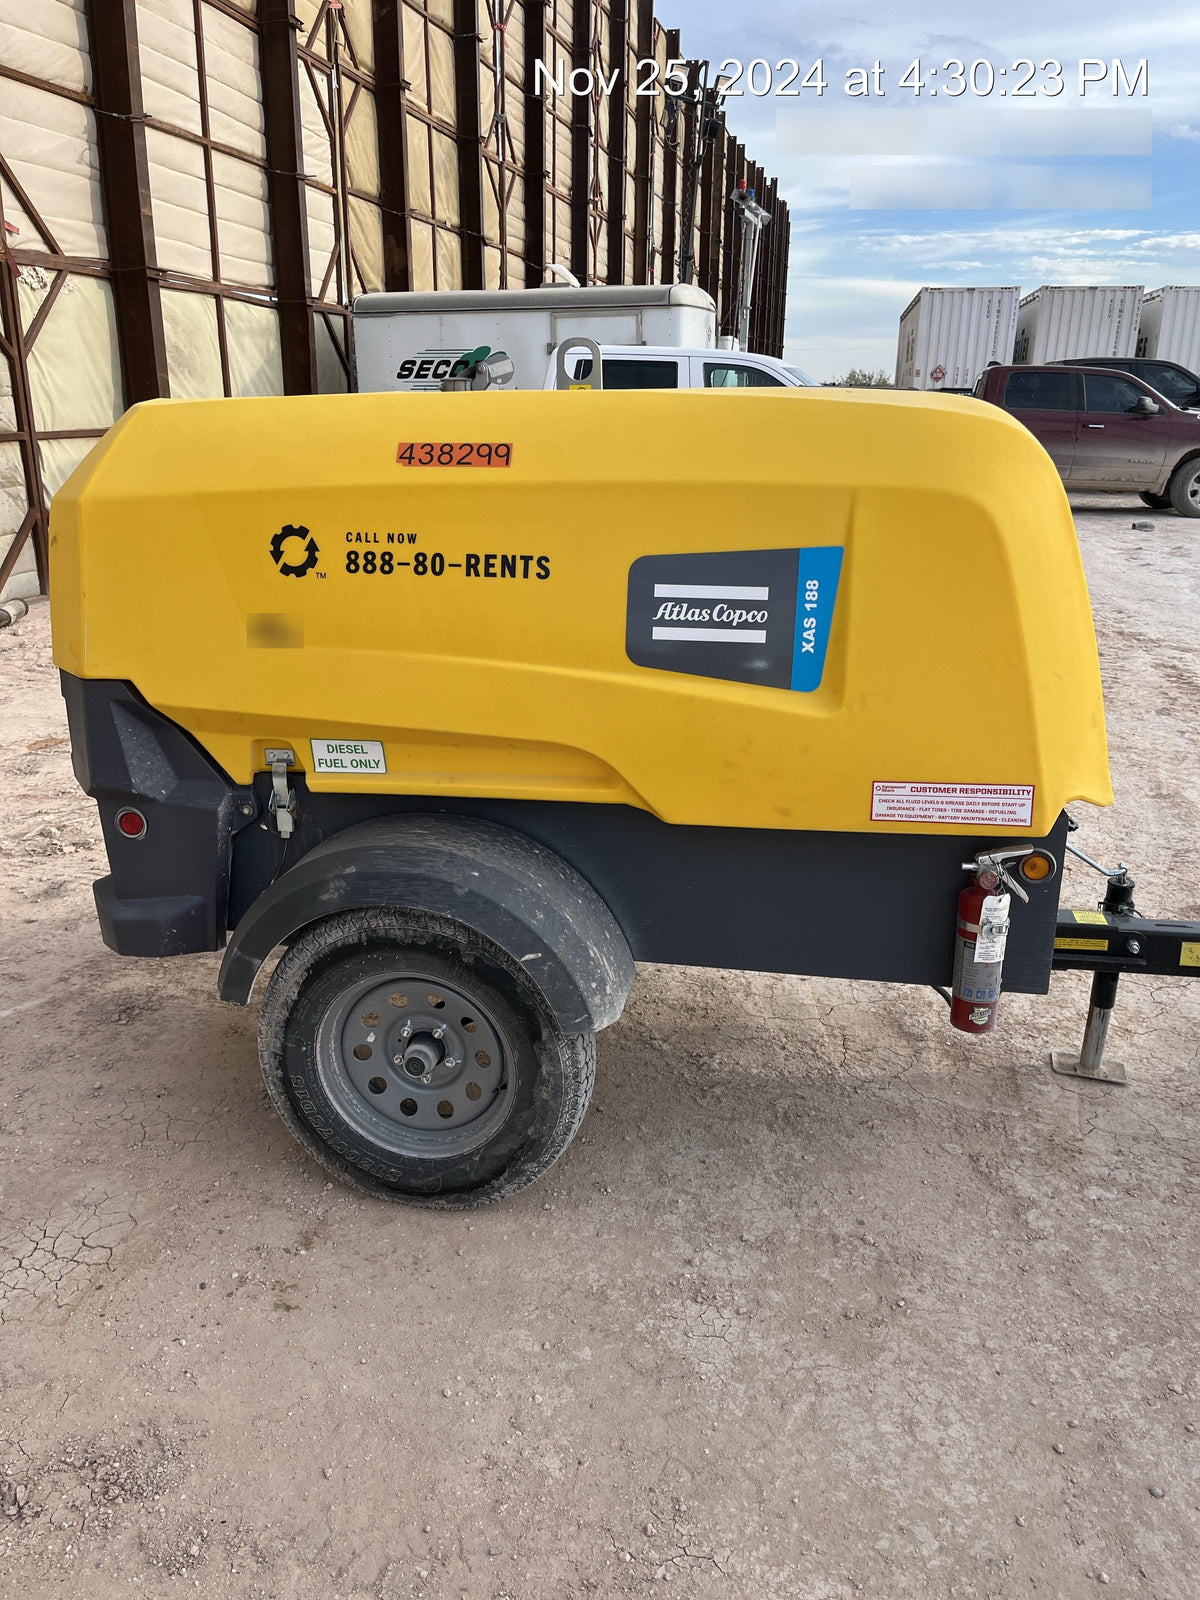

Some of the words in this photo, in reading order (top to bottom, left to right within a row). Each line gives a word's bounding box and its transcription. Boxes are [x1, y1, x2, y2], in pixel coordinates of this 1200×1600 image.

[396, 359, 484, 380] SECO
[398, 443, 511, 466] 438299
[346, 532, 380, 543] CALL
[387, 533, 418, 544] NOW
[346, 550, 551, 580] 888-80-RENTS
[805, 579, 819, 611] 188
[652, 602, 711, 622] Atlas
[713, 603, 768, 626] Copco
[802, 616, 817, 653] XAS
[327, 744, 368, 754] DIESEL
[318, 758, 348, 769] FUEL
[350, 759, 381, 769] ONLY
[910, 786, 958, 794] CUSTOMER
[959, 787, 1032, 796] RESPONSIBILITY
